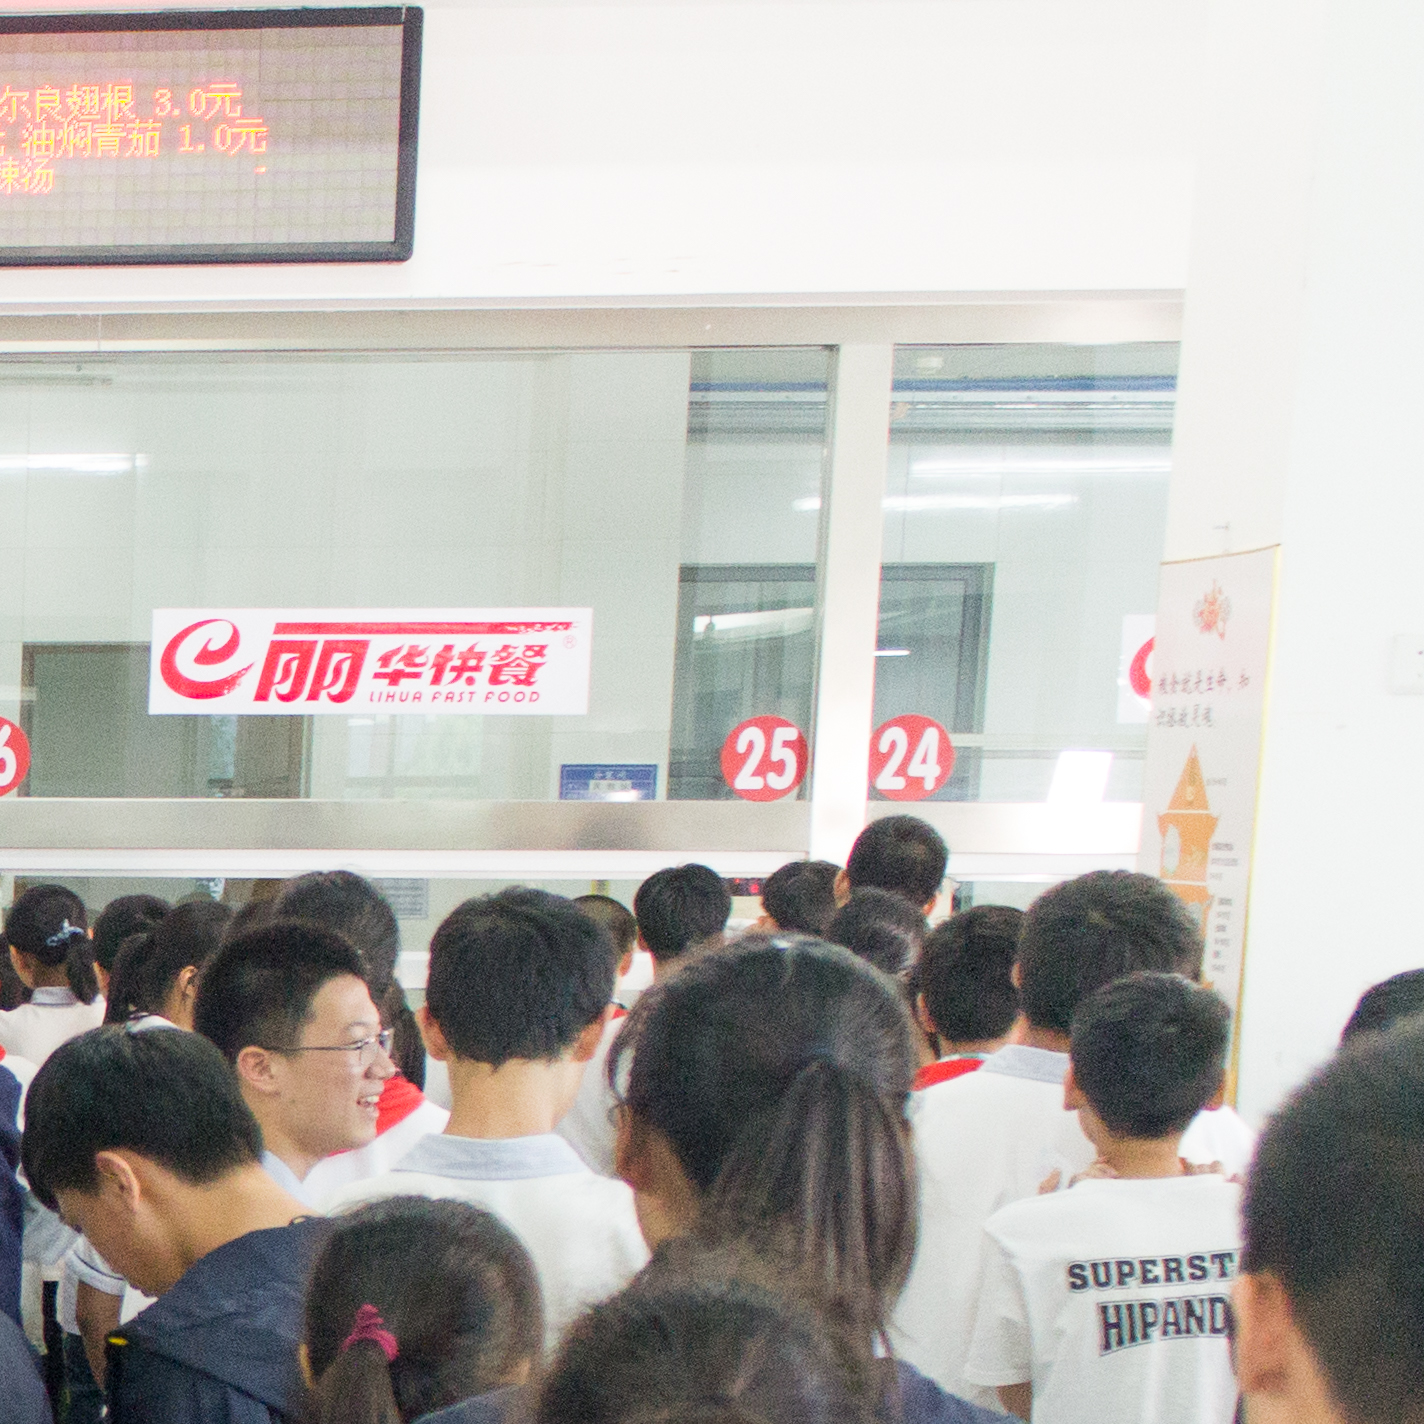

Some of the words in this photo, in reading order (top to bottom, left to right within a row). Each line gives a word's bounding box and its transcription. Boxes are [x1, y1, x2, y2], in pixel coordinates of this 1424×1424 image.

[153, 82, 244, 121] 3.0元
[22, 119, 164, 158] 油焖青茄
[177, 118, 270, 156] 1.0元
[370, 690, 422, 703] LIHUA
[431, 690, 477, 703] FAST
[485, 690, 540, 703] FOOD
[733, 726, 798, 790] 25
[875, 726, 941, 790] 24
